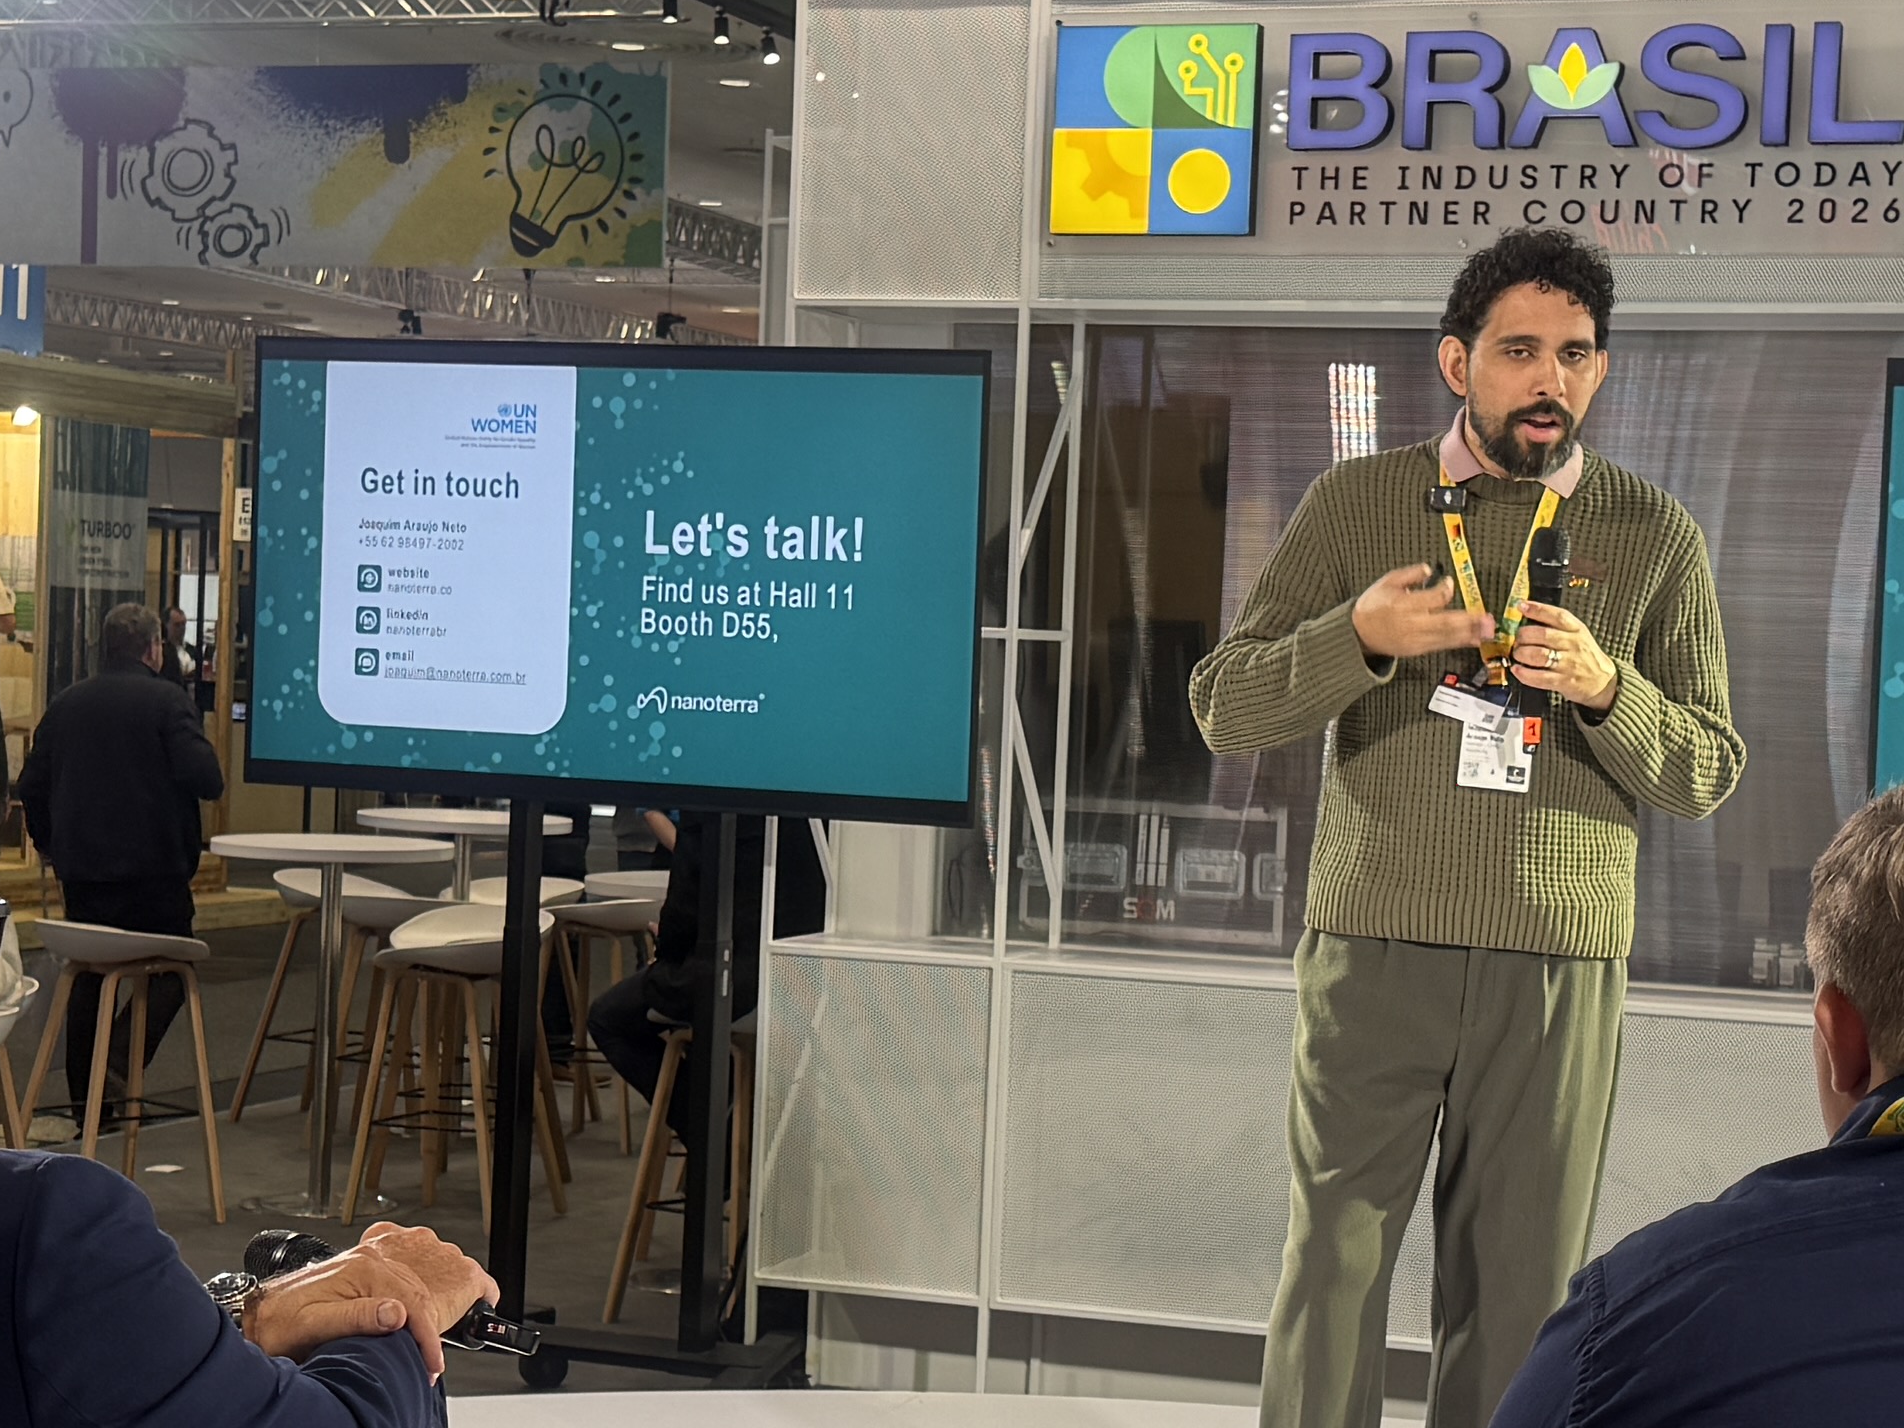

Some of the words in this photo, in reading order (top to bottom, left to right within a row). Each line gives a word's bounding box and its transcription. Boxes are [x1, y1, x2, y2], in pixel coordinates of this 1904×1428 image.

[1292, 166, 1369, 192] THE
[1397, 163, 1629, 192] INDUSTRY
[1658, 161, 1714, 189] OF
[1745, 159, 1904, 189] TODAY
[1289, 198, 1493, 227] PARTNER
[1522, 197, 1753, 226] COUNTRY
[1787, 197, 1903, 225] 2026
[513, 404, 538, 418] UN
[471, 418, 538, 434] WOMEN
[360, 467, 405, 494] Get
[413, 468, 436, 496] in
[445, 471, 520, 499] touch
[403, 519, 439, 534] Araujo
[442, 521, 467, 533] Neto
[645, 509, 750, 558] Let's
[763, 515, 864, 562] talk!
[381, 536, 395, 548] 62
[387, 567, 430, 579] website
[642, 575, 693, 603] Find
[701, 583, 729, 605] us
[737, 581, 761, 606] at
[769, 580, 817, 609] Hall
[826, 582, 854, 611] 11
[640, 607, 713, 636] Booth
[722, 610, 779, 643] D55,
[385, 650, 415, 661] email
[670, 694, 759, 713] nanoterra
